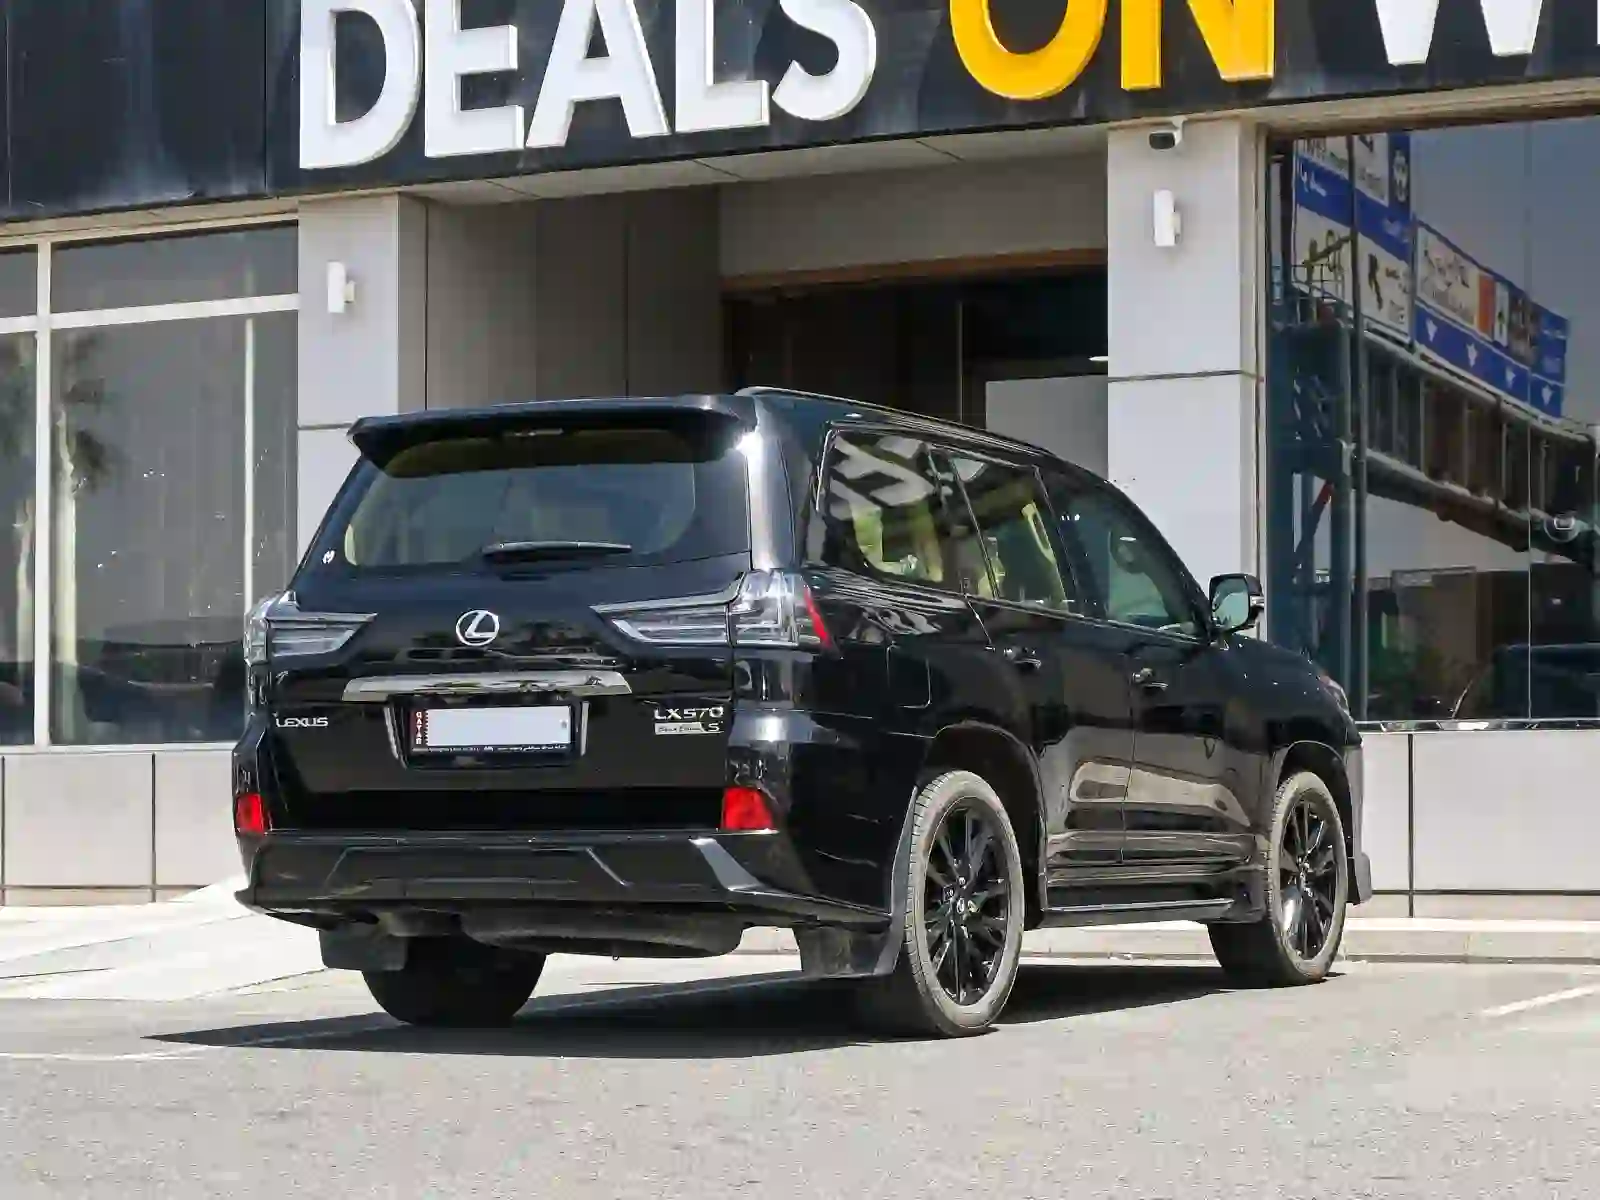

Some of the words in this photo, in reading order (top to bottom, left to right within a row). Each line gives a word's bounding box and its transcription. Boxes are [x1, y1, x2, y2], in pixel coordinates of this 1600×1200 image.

[300, 0, 878, 169] DEALS
[275, 716, 329, 728] LEXUS
[415, 711, 423, 745] QATAR
